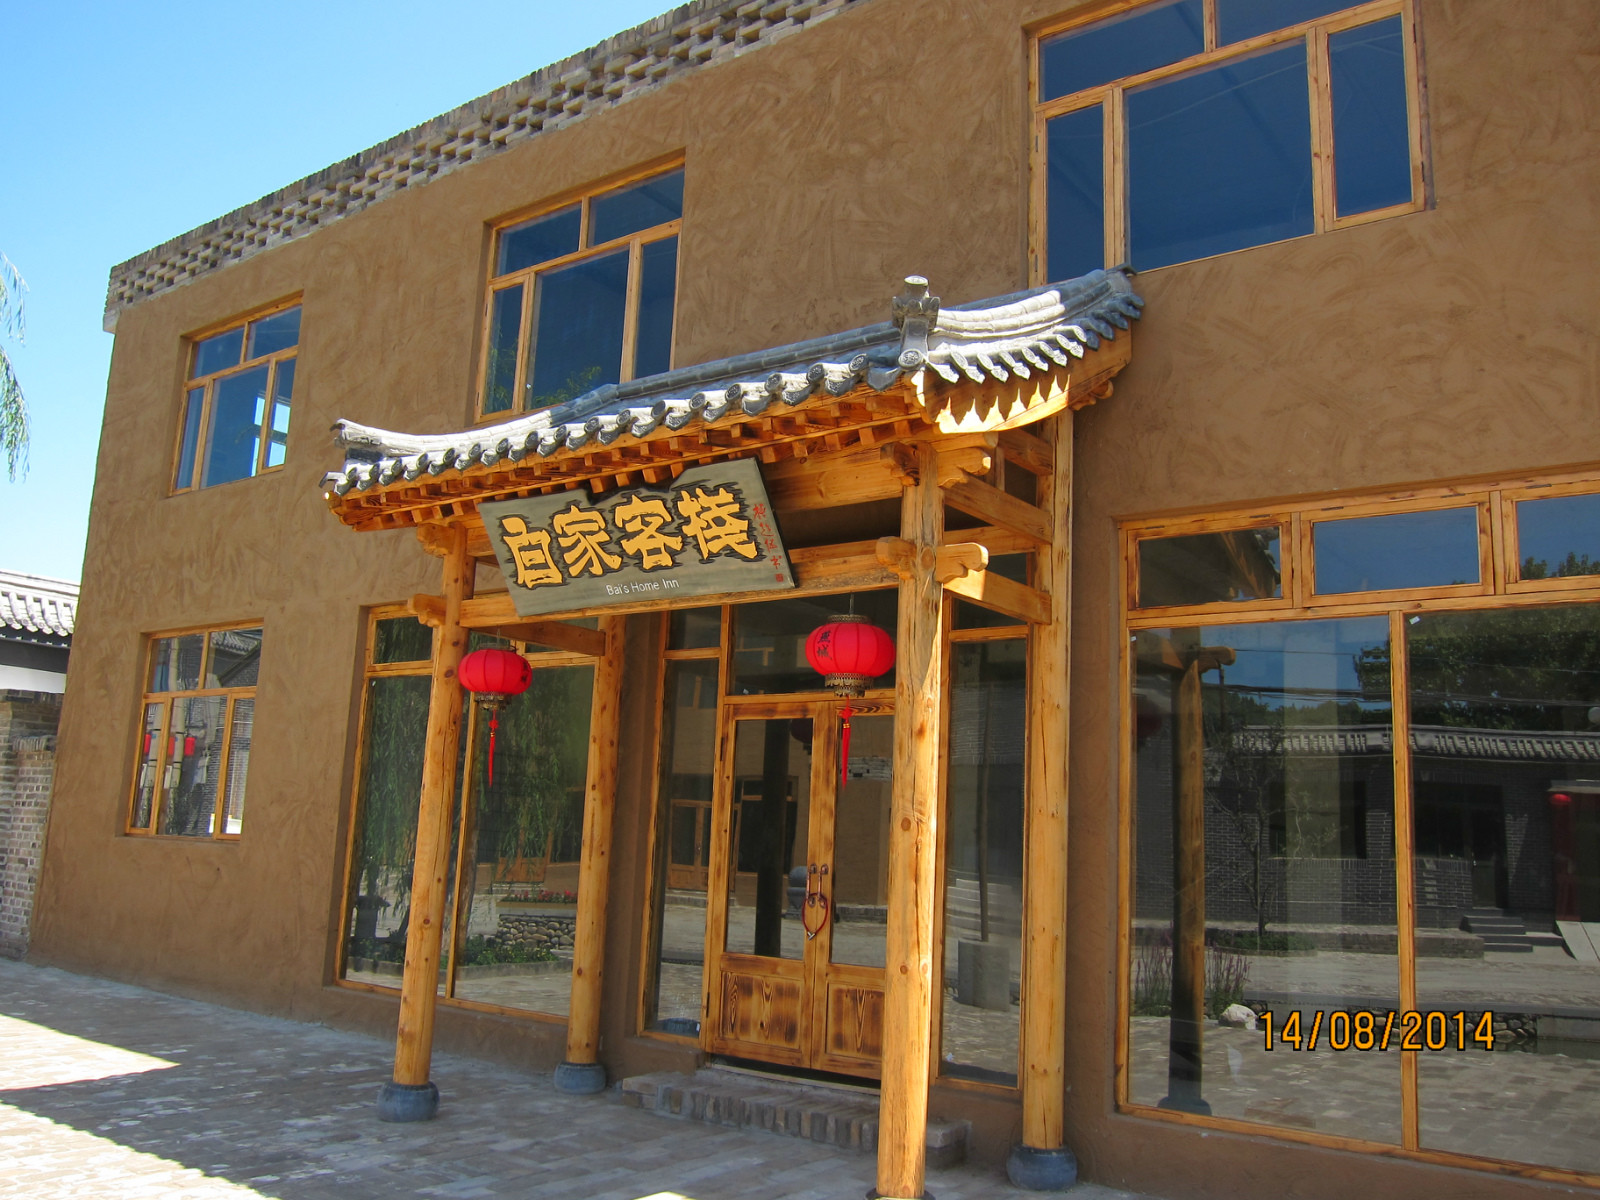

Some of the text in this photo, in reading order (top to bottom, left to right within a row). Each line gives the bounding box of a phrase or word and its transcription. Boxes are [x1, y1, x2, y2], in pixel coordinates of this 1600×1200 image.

[605, 578, 680, 596] Bai's Home Inn
